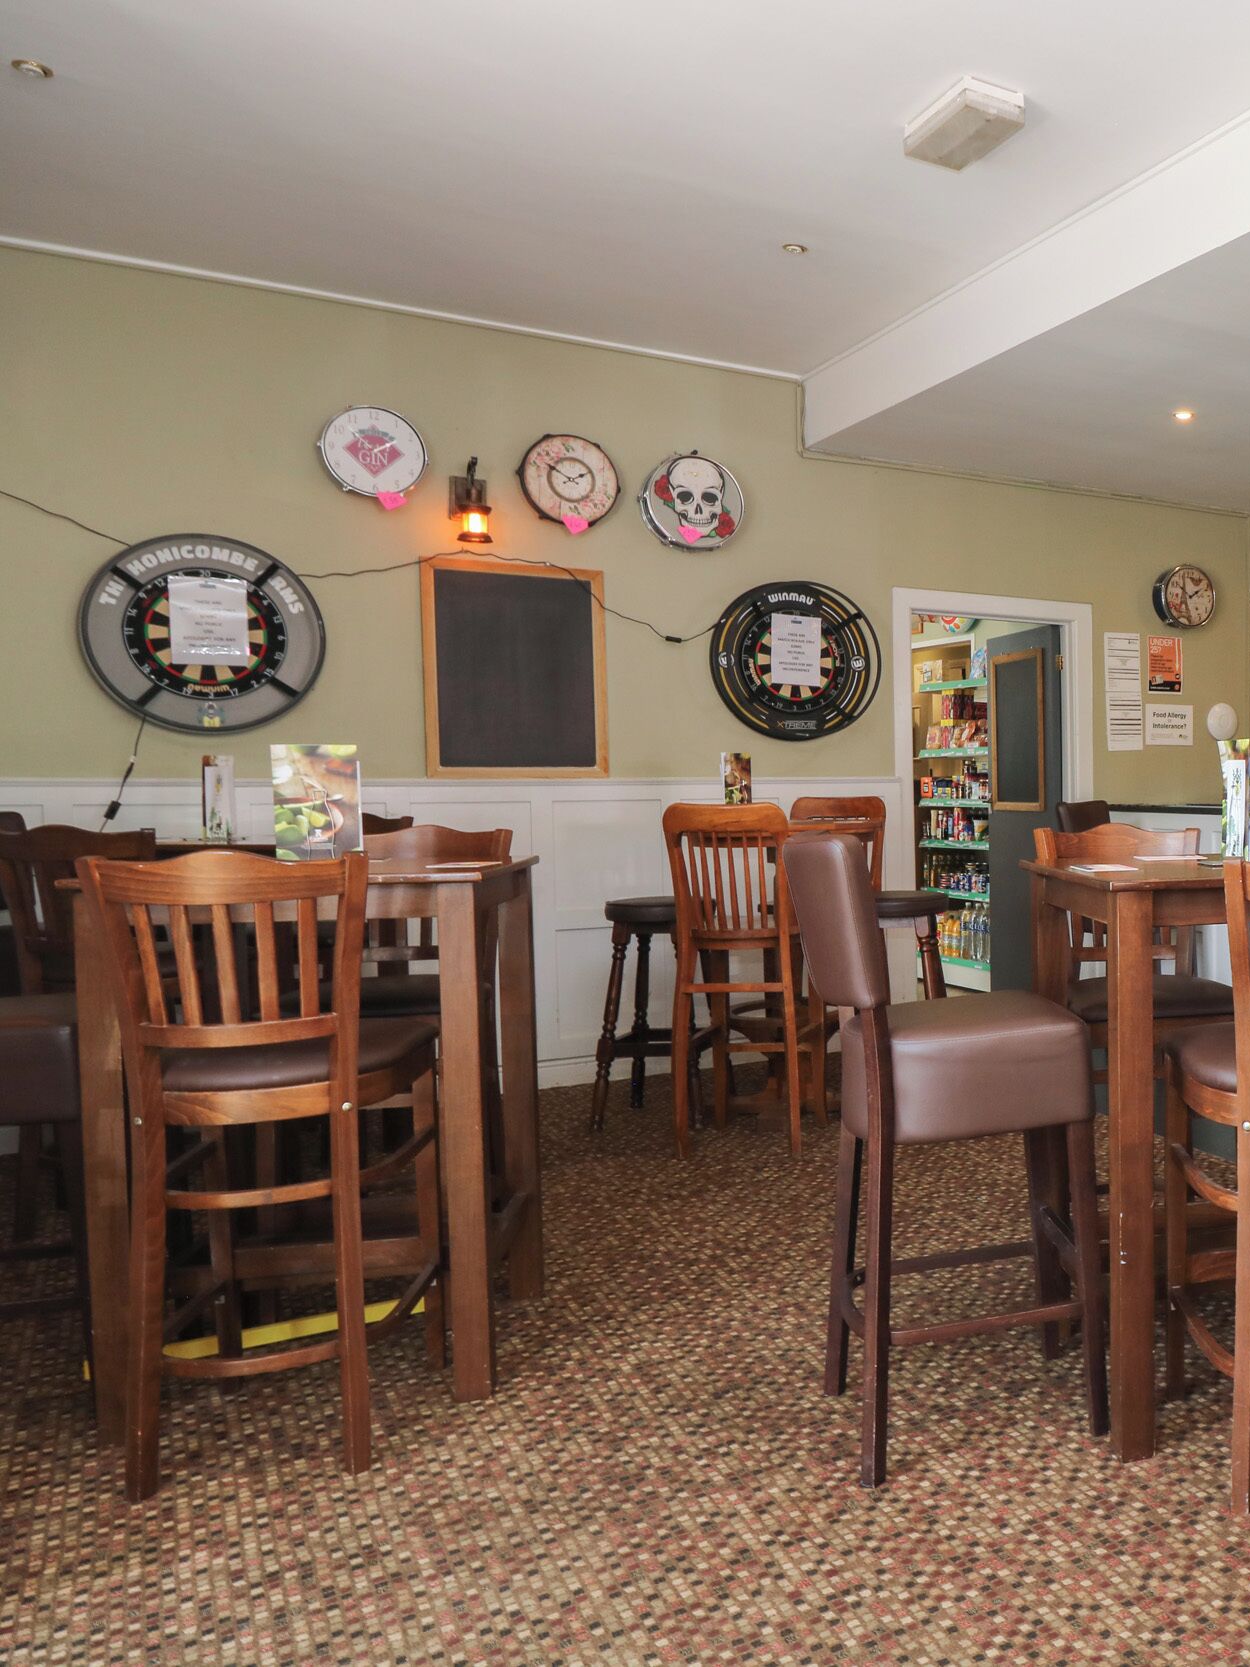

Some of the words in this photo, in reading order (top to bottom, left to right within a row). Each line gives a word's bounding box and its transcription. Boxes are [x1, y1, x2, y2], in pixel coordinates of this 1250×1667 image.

[359, 450, 389, 466] GIN
[99, 575, 128, 605] TH
[126, 545, 259, 576] HONICOMBE
[768, 592, 813, 605] WINMAU
[1150, 638, 1173, 646] UNDER
[1150, 646, 1162, 654] 25?
